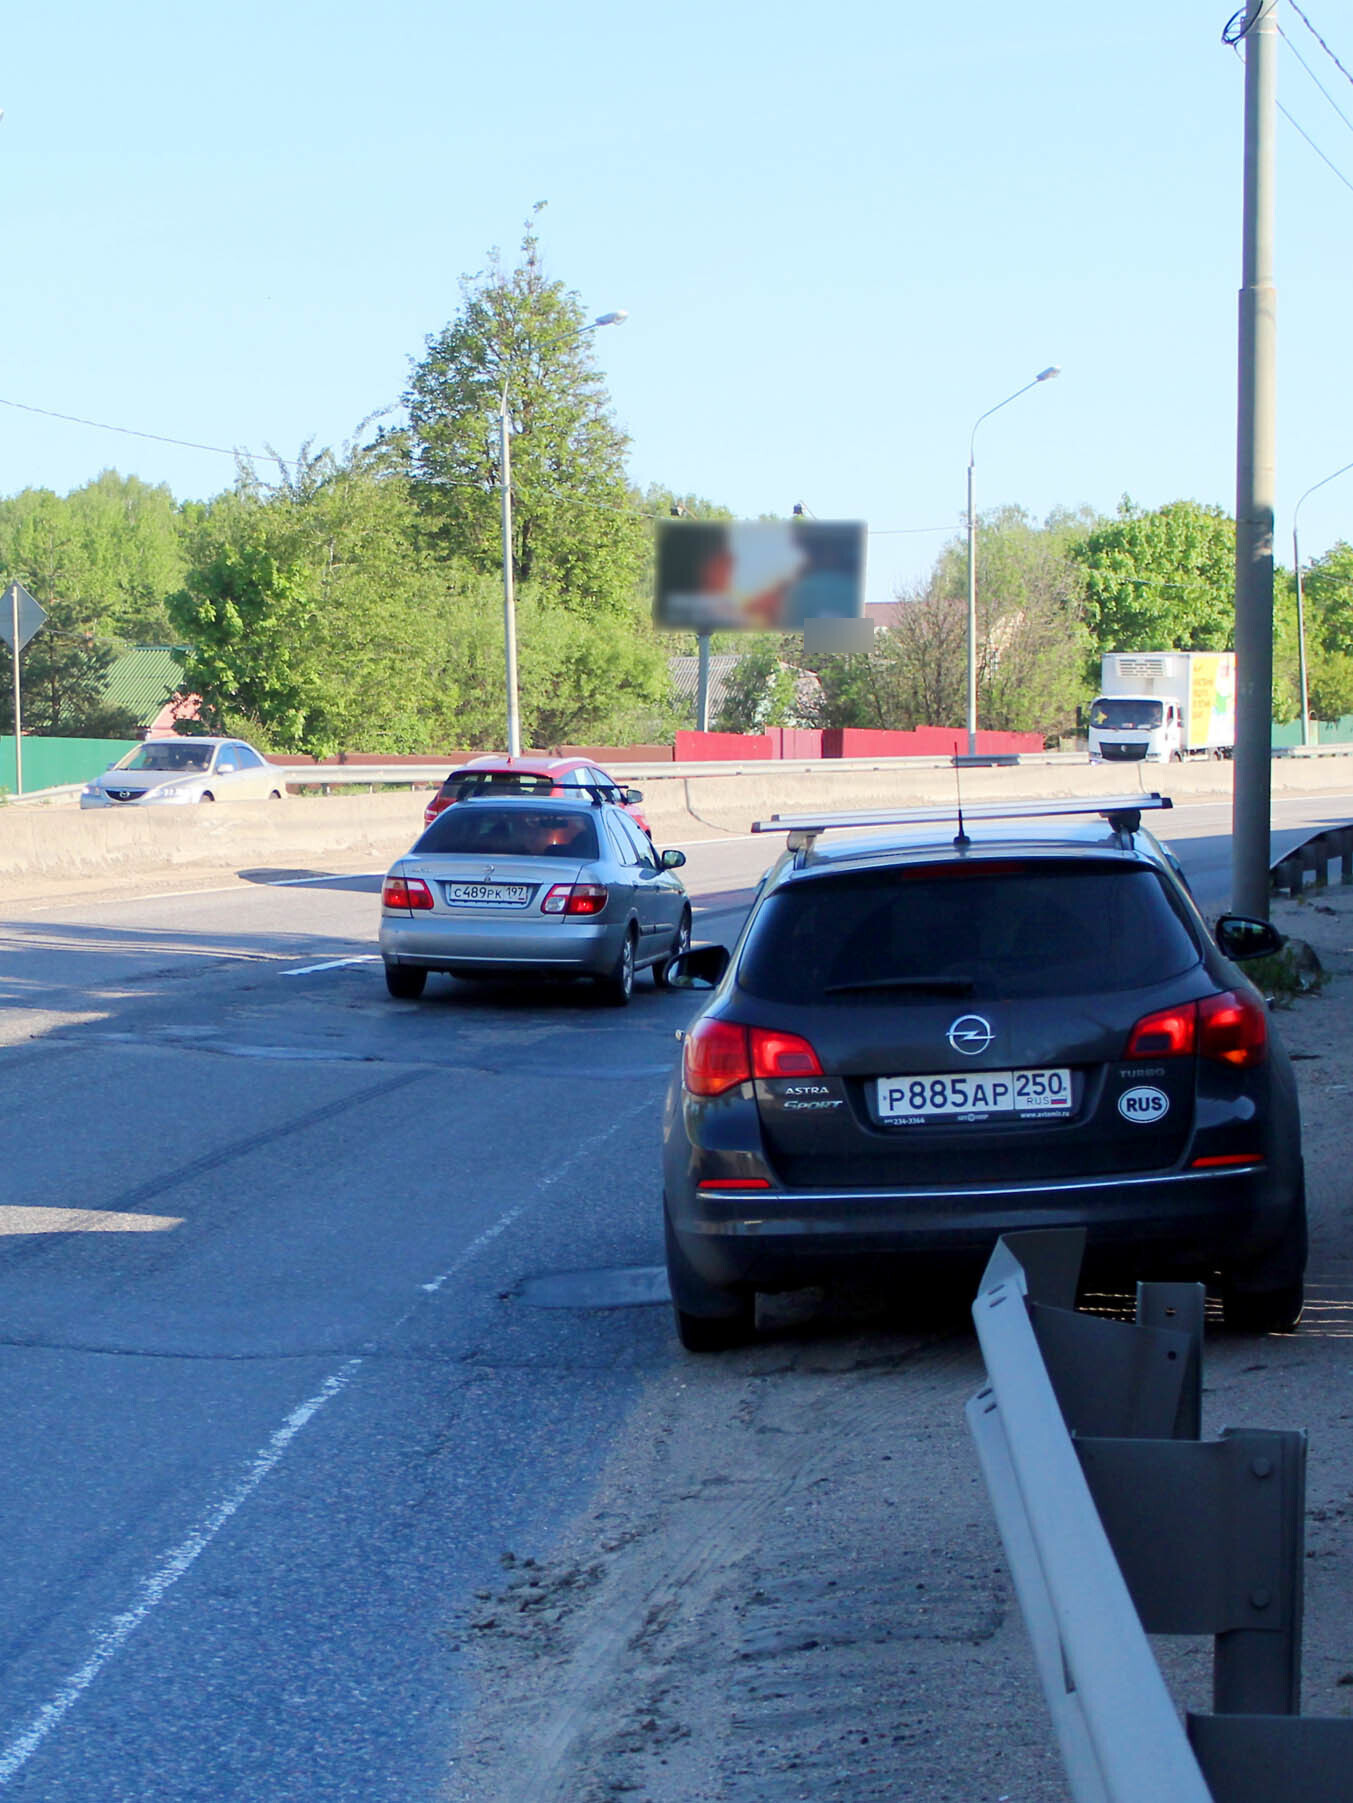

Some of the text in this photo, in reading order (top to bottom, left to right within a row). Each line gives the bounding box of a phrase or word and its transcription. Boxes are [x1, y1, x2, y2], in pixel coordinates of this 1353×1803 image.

[506, 886, 524, 898] 197
[1119, 1068, 1166, 1079] TURBO
[785, 1086, 830, 1096] ASTRA
[888, 1072, 1063, 1112] Р885АР 250
[1026, 1096, 1050, 1106] RUS
[1126, 1096, 1163, 1113] RUS
